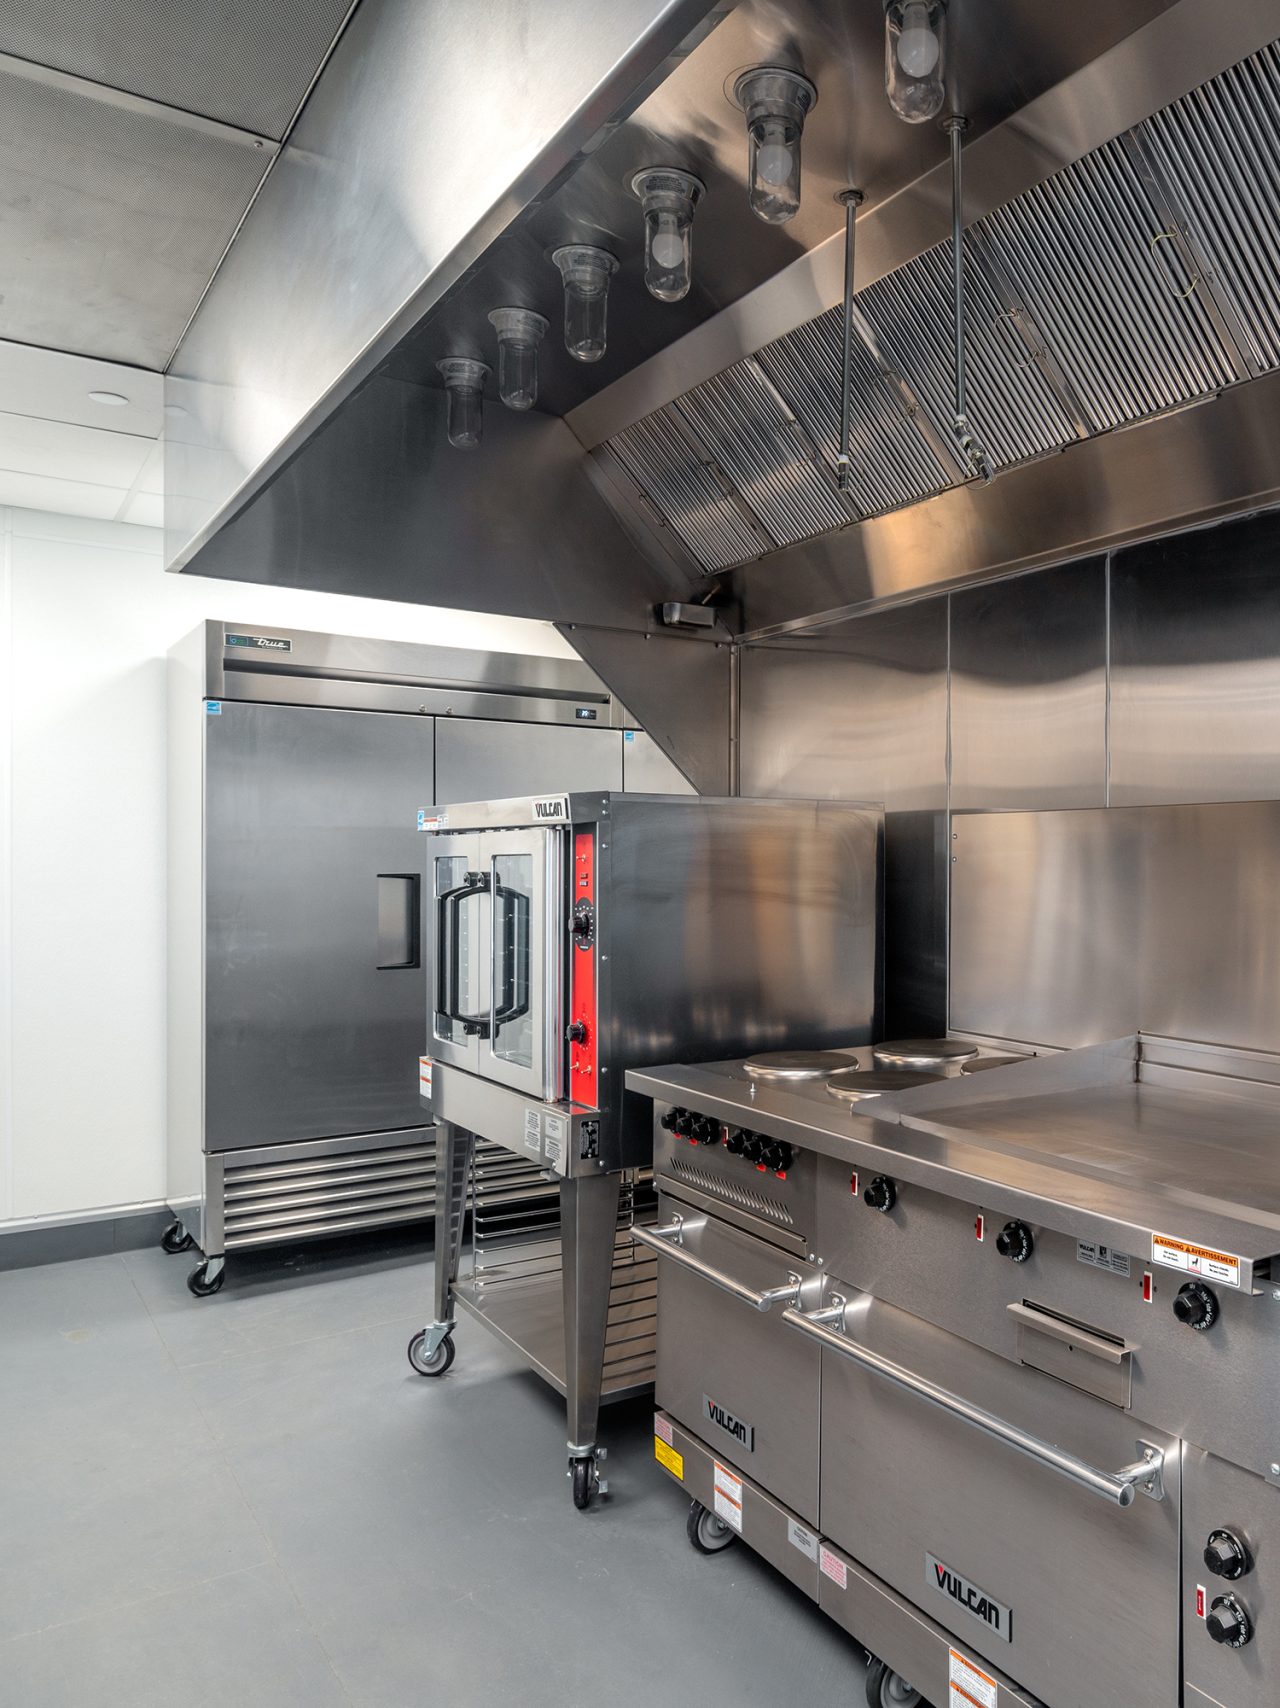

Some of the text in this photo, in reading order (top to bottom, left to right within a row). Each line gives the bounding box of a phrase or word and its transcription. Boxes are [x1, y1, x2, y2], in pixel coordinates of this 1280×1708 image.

[535, 801, 563, 818] VULCAN
[1160, 1238, 1184, 1251] WARNING
[1191, 1247, 1237, 1266] AVERTISSEMENT
[708, 1400, 746, 1444] VULCAN
[934, 1562, 1000, 1631] VULCAN
